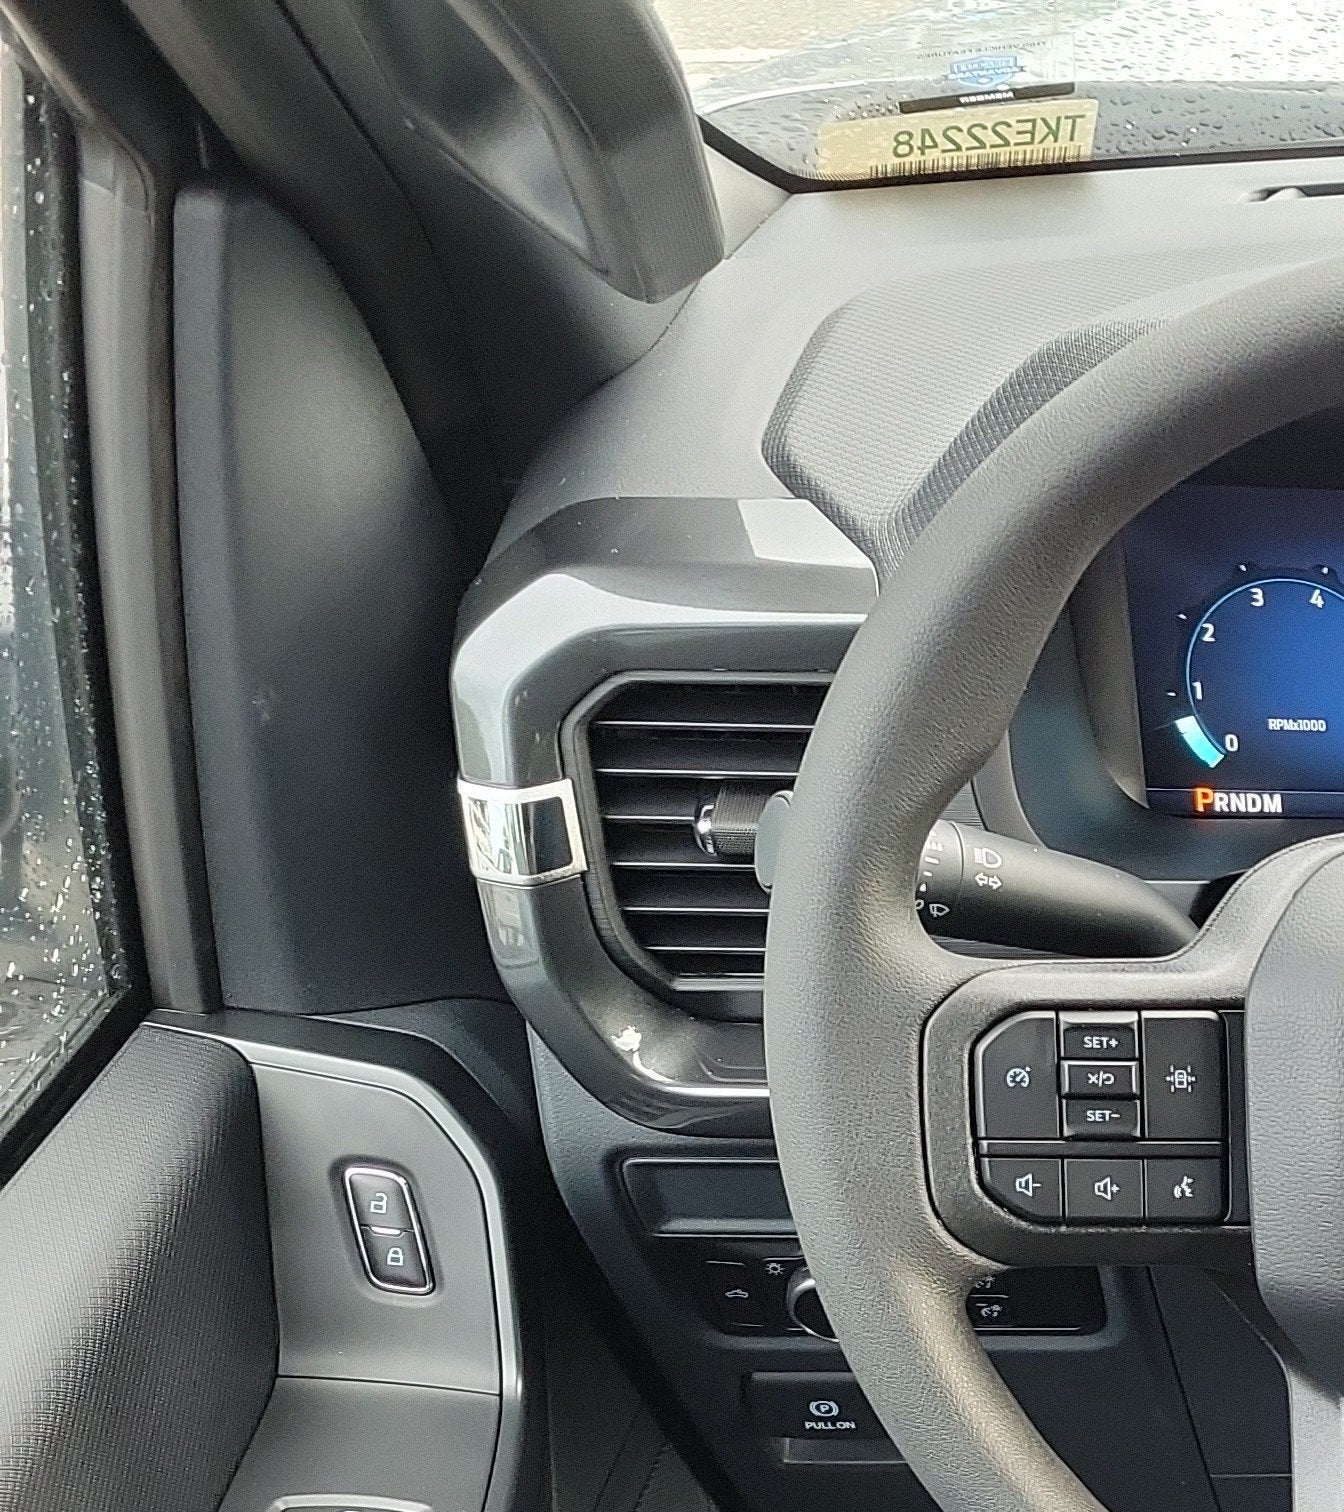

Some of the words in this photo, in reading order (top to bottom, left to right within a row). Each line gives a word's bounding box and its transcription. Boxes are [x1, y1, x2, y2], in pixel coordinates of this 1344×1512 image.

[1250, 588, 1264, 606] 3
[1309, 589, 1325, 608] 4
[1202, 623, 1216, 642] 2
[1193, 682, 1203, 700] 1
[1267, 717, 1327, 732] RPMx1000
[1225, 734, 1239, 752] 0
[1083, 1036, 1119, 1050] SET+
[805, 1421, 837, 1429] PULL
[836, 1421, 856, 1429] ON
